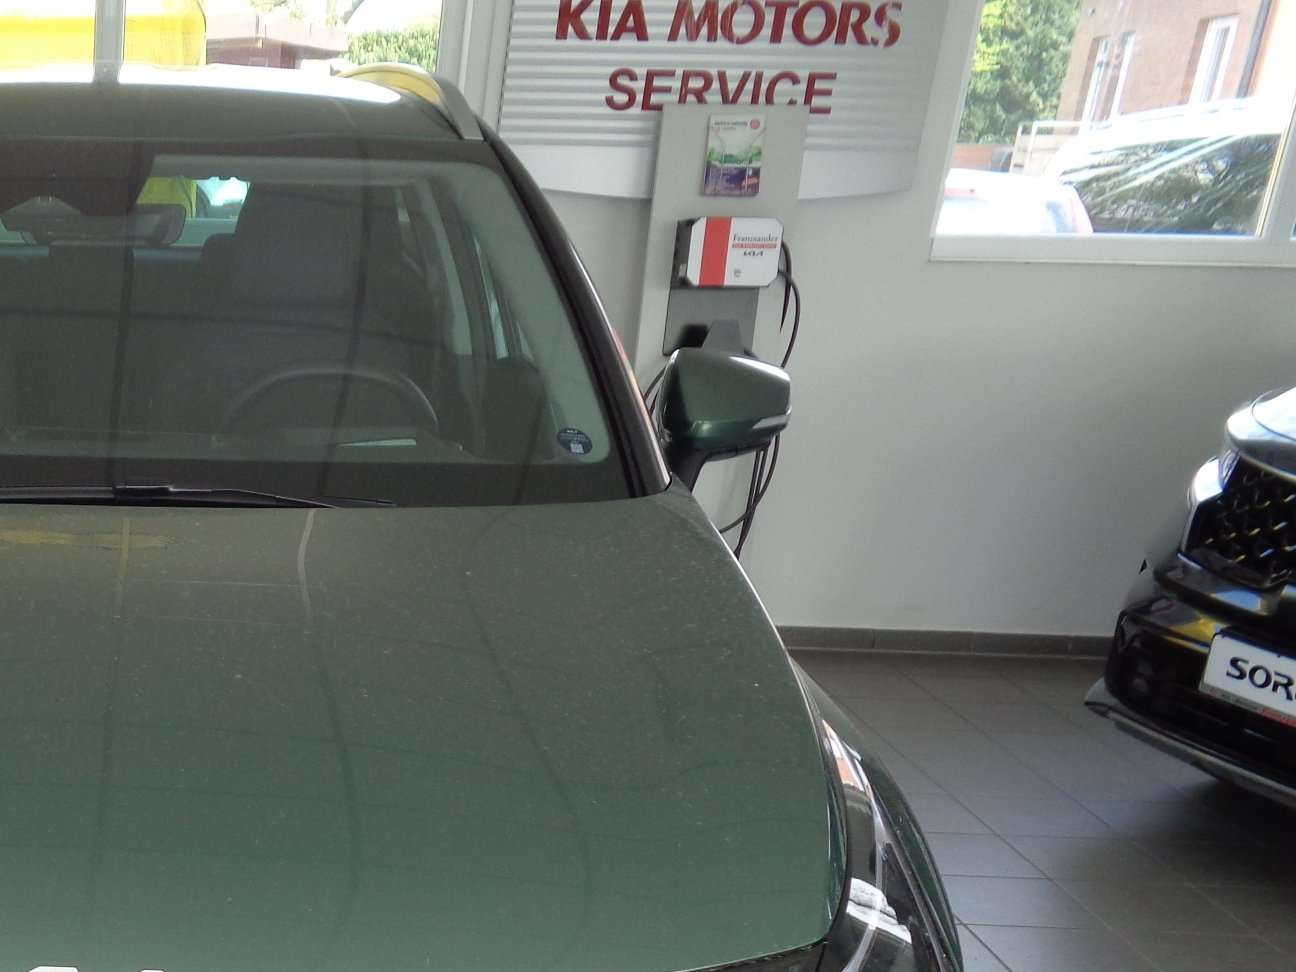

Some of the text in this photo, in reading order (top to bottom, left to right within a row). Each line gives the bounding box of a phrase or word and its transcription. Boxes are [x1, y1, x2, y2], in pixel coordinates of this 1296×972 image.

[555, 0, 901, 47] KIA MOTORS
[605, 68, 837, 114] SERVICE
[1226, 656, 1296, 701] SOR
